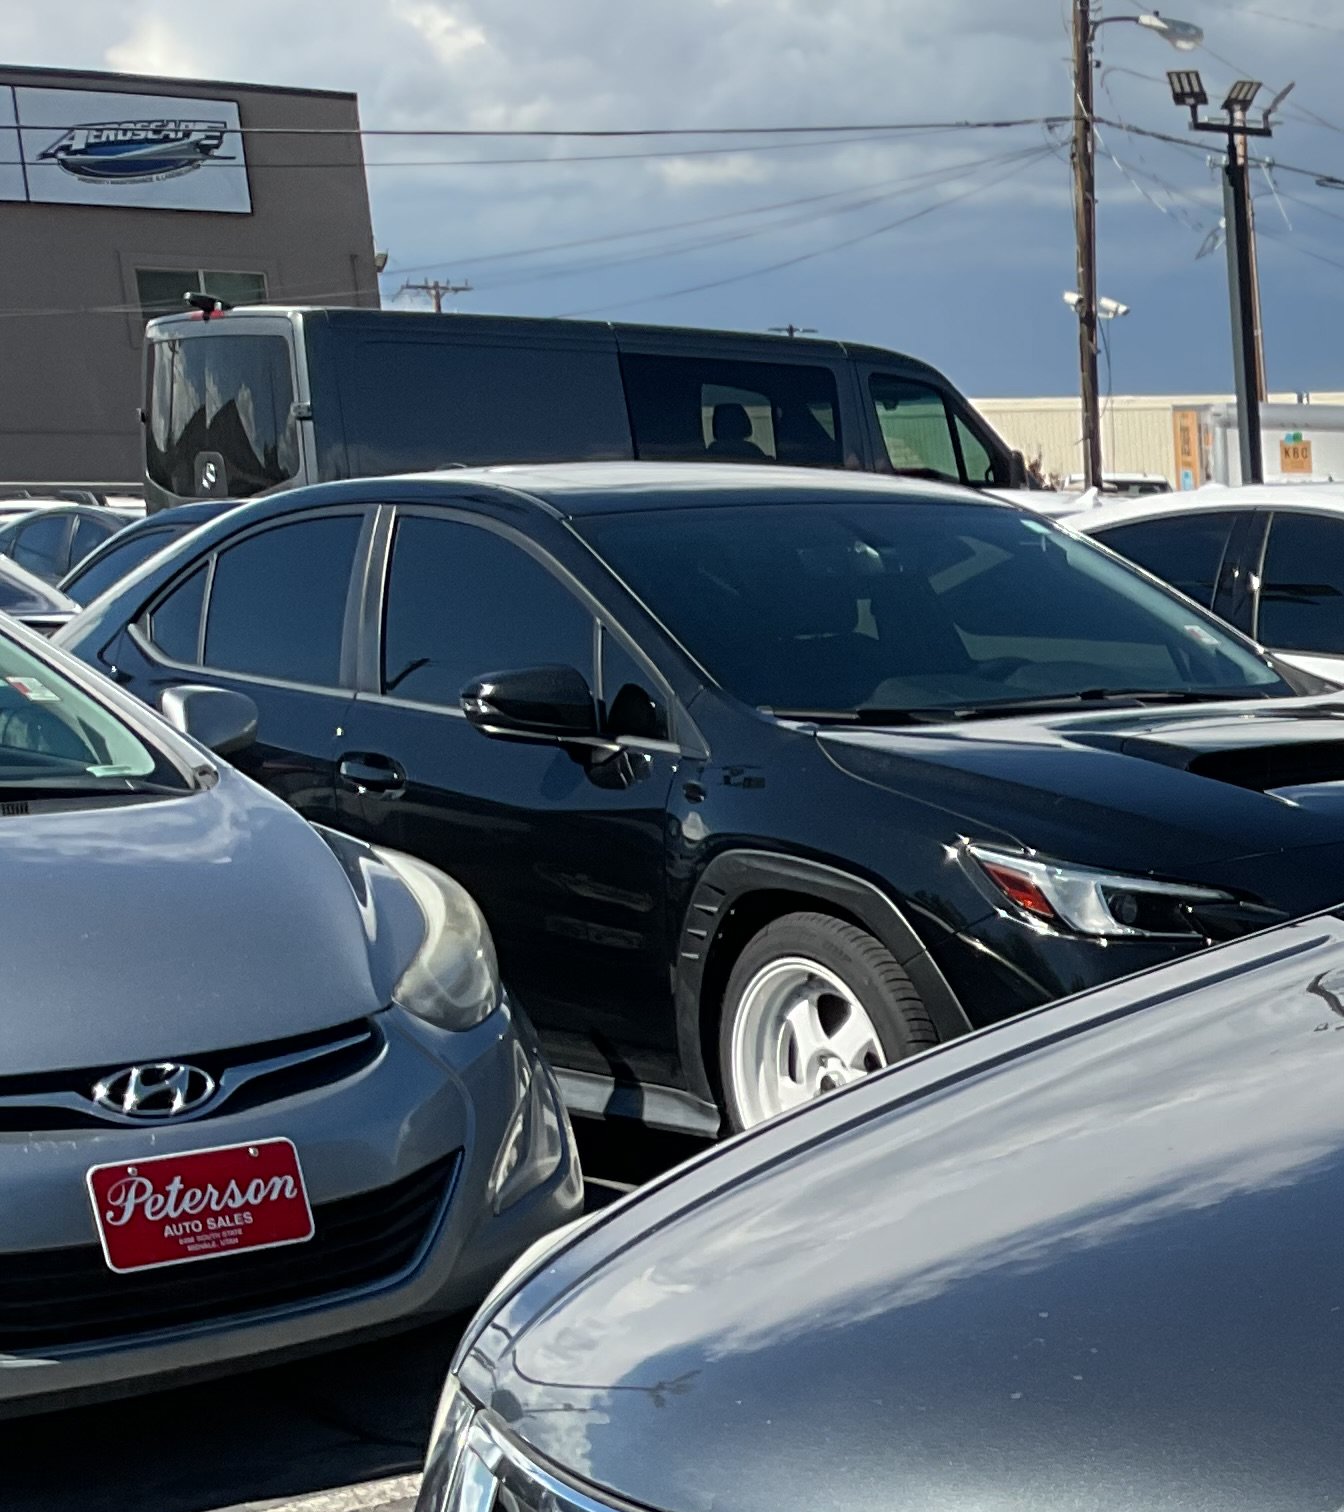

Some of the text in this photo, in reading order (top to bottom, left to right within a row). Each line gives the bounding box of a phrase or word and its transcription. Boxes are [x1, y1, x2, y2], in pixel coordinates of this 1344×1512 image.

[106, 1174, 298, 1226] Peterson
[164, 1211, 254, 1238] AUTO SALES
